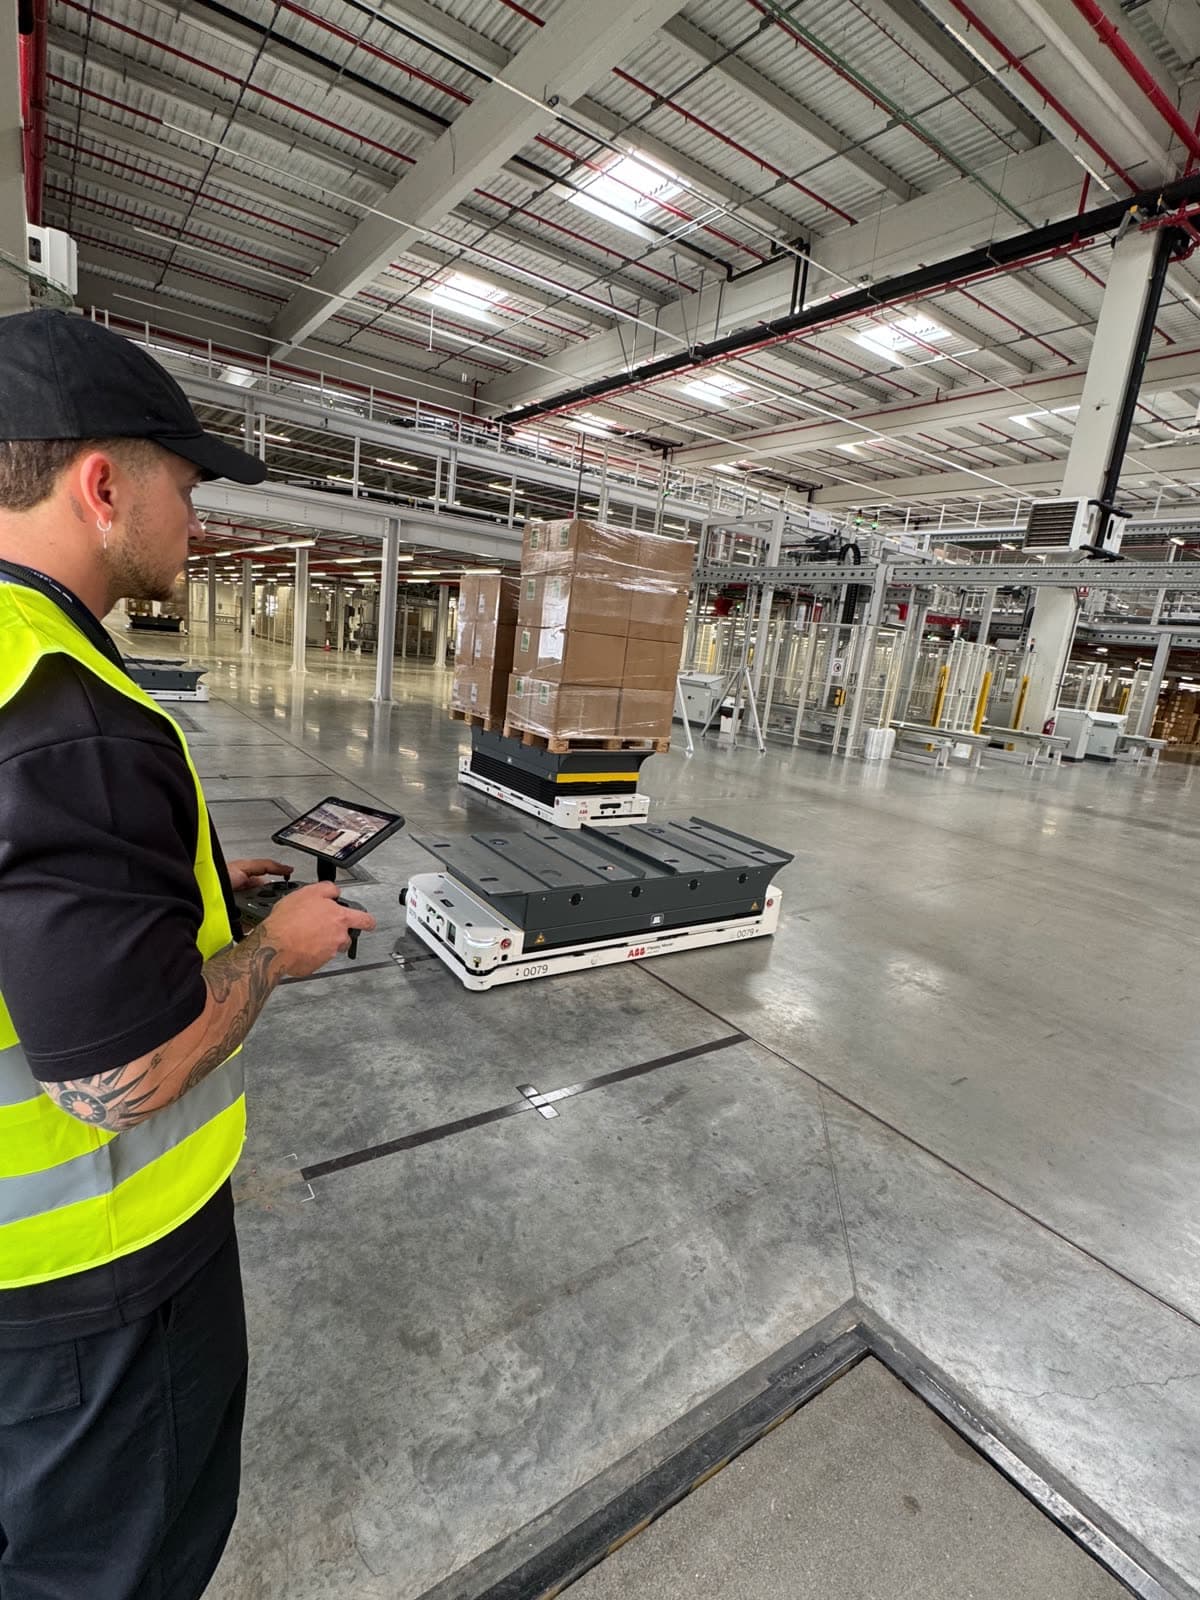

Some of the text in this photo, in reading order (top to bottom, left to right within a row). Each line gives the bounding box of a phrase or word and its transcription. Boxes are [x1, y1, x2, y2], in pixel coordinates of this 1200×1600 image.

[737, 928, 755, 938] 0079
[627, 947, 645, 958] ABB
[523, 964, 549, 977] 0079
